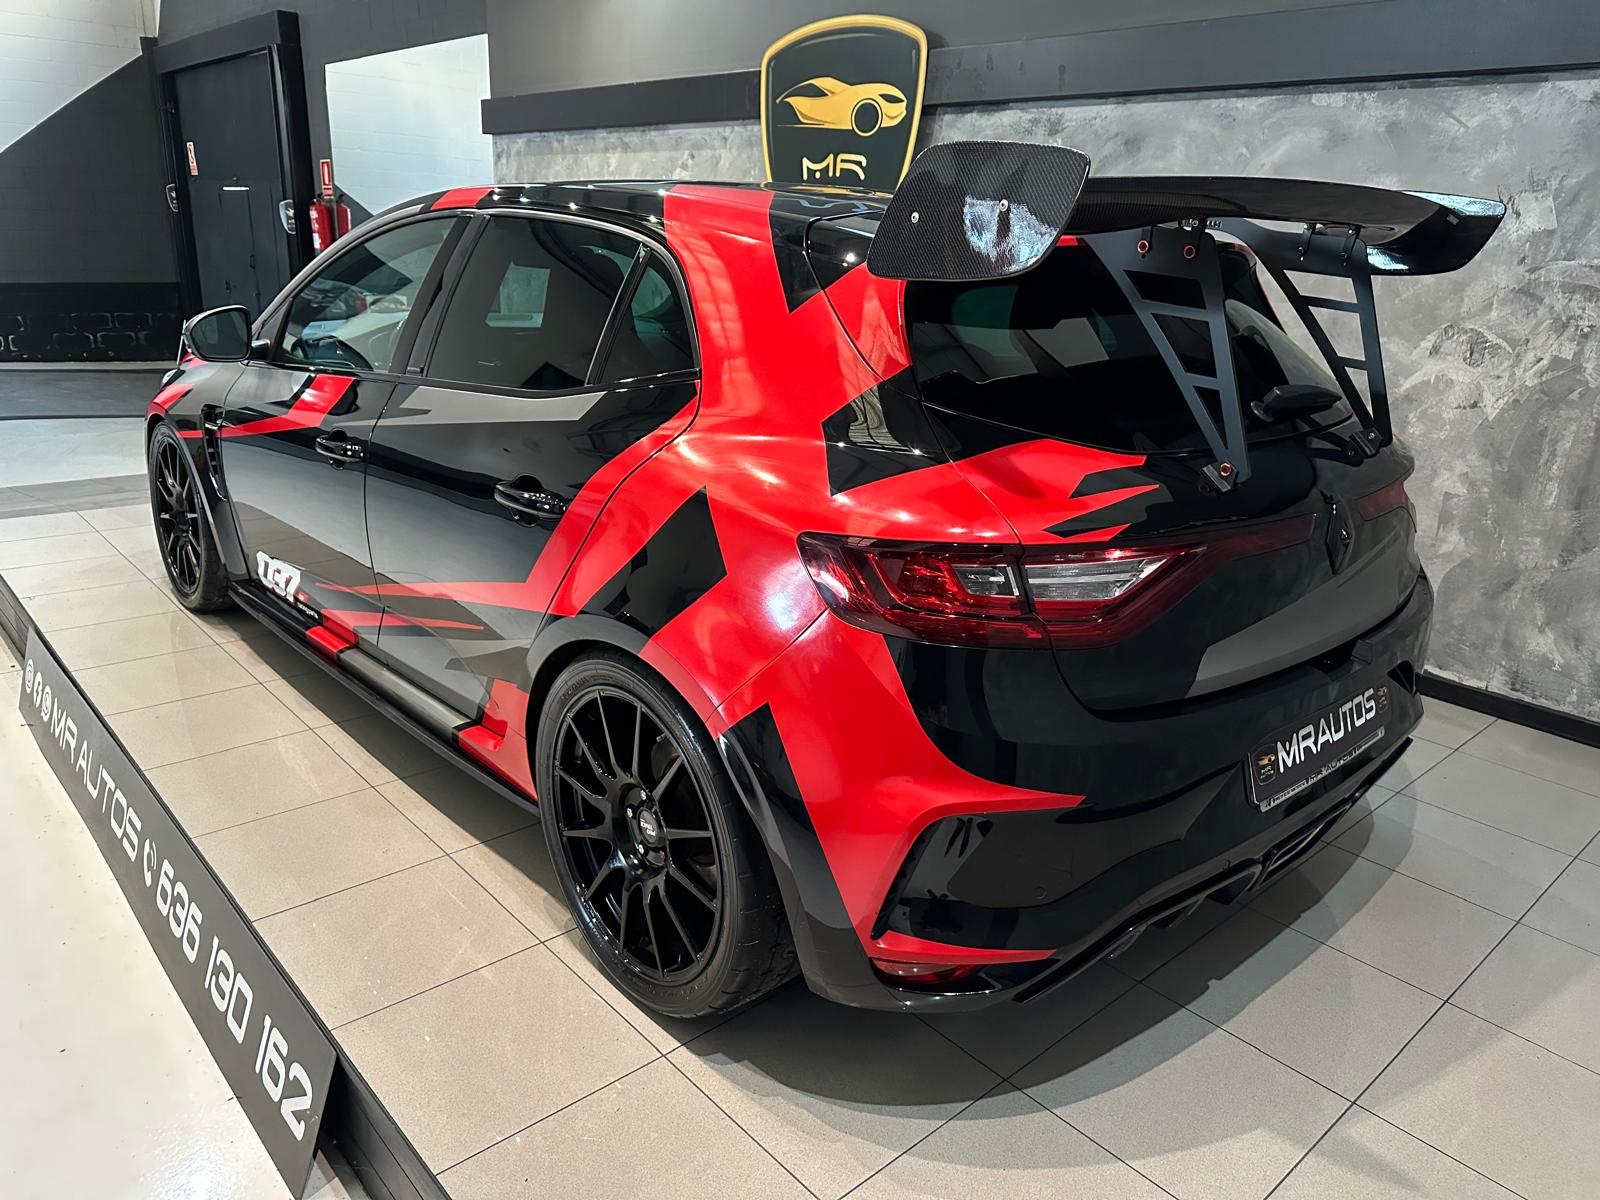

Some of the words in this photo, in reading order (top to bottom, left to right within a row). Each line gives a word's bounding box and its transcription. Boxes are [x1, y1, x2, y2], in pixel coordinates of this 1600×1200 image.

[802, 153, 867, 180] MR
[50, 697, 78, 764] MR
[75, 739, 142, 862] AUTOS
[156, 859, 203, 963] 636
[204, 935, 253, 1044] 130
[255, 1014, 313, 1141] 162
